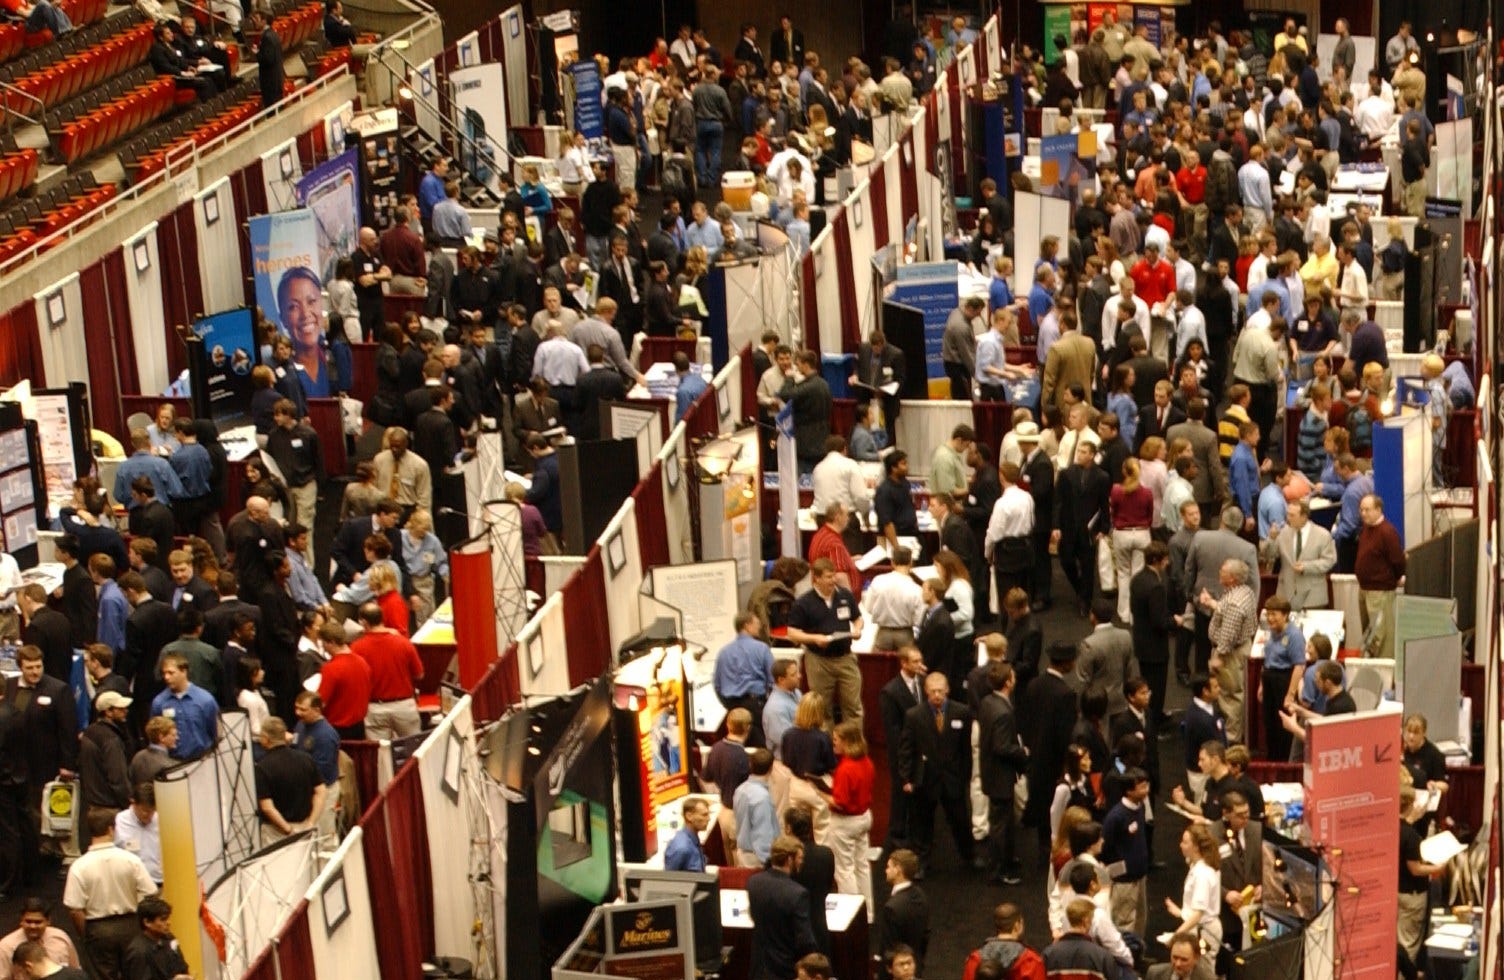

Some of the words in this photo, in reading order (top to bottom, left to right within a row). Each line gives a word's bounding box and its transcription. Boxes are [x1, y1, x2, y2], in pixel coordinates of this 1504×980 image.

[256, 254, 312, 274] heroes
[1318, 746, 1363, 774] IBM
[622, 928, 672, 944] Marines
